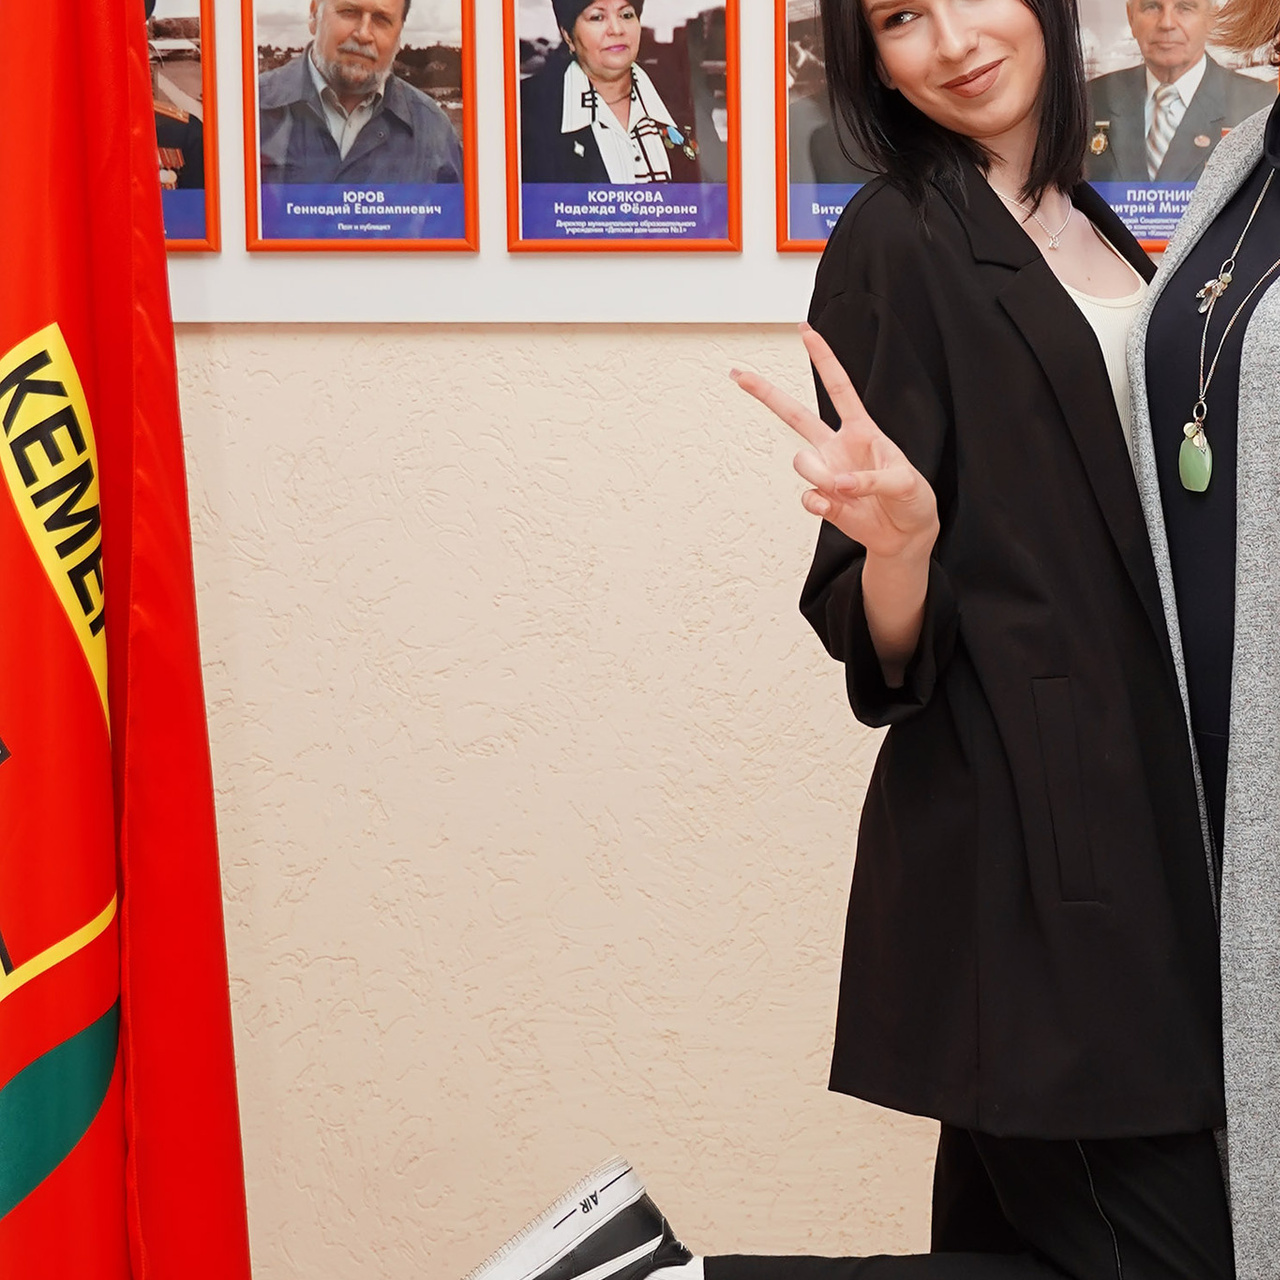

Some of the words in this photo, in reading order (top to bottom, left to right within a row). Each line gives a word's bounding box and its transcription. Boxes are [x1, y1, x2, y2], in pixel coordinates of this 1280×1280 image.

[343, 191, 385, 203] ЮРОВ
[587, 190, 664, 203] КОРЯКОВА
[286, 203, 350, 216] Геннадий
[354, 203, 442, 215] Евлампиевич
[554, 202, 616, 216] Надежда
[619, 202, 698, 218] Фёдоровна
[0, 349, 105, 638] КЕМЕ
[579, 1190, 598, 1214] AIR
